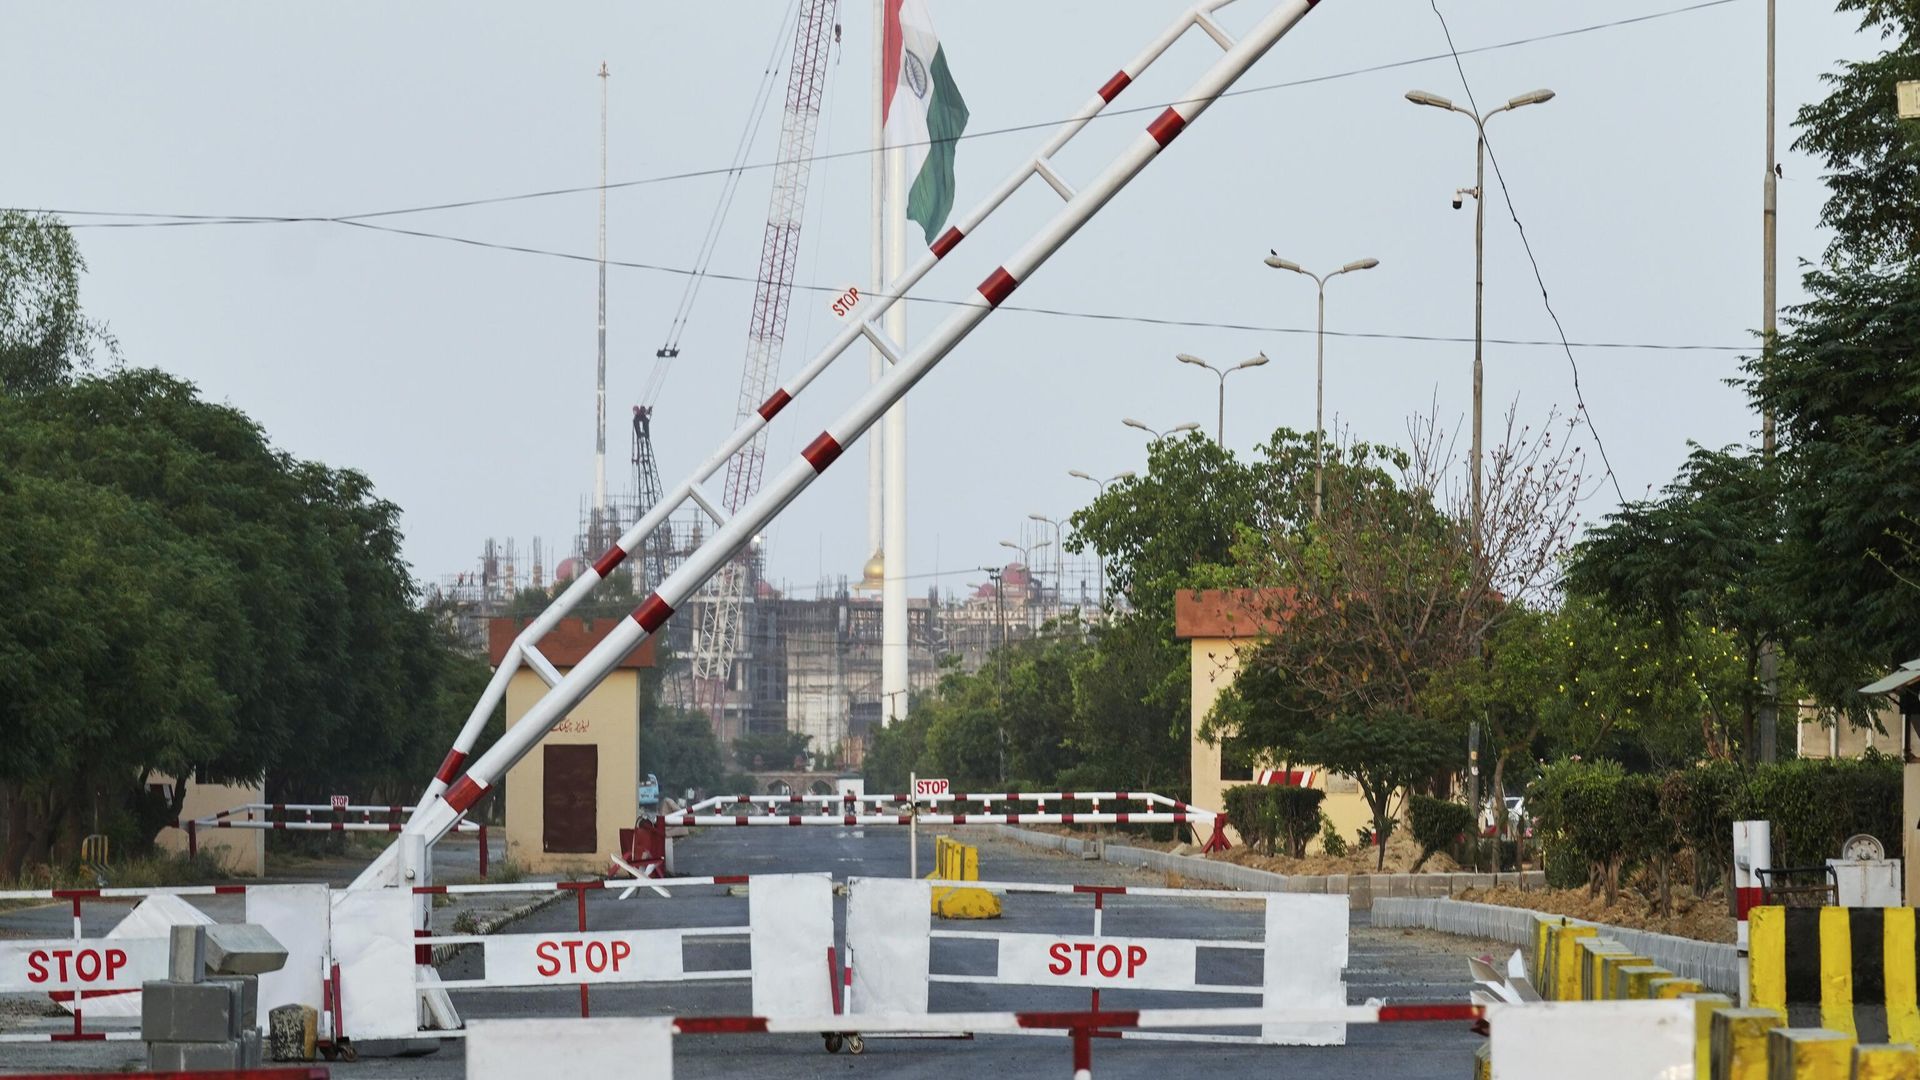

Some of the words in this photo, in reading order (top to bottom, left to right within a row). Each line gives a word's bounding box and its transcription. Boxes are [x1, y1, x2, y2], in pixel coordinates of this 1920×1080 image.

[832, 287, 859, 317] STOP
[332, 796, 348, 806] STOP
[917, 780, 948, 794] STOP
[28, 949, 127, 983] STOP
[536, 940, 631, 977] STOP
[1048, 943, 1148, 979] STOP
